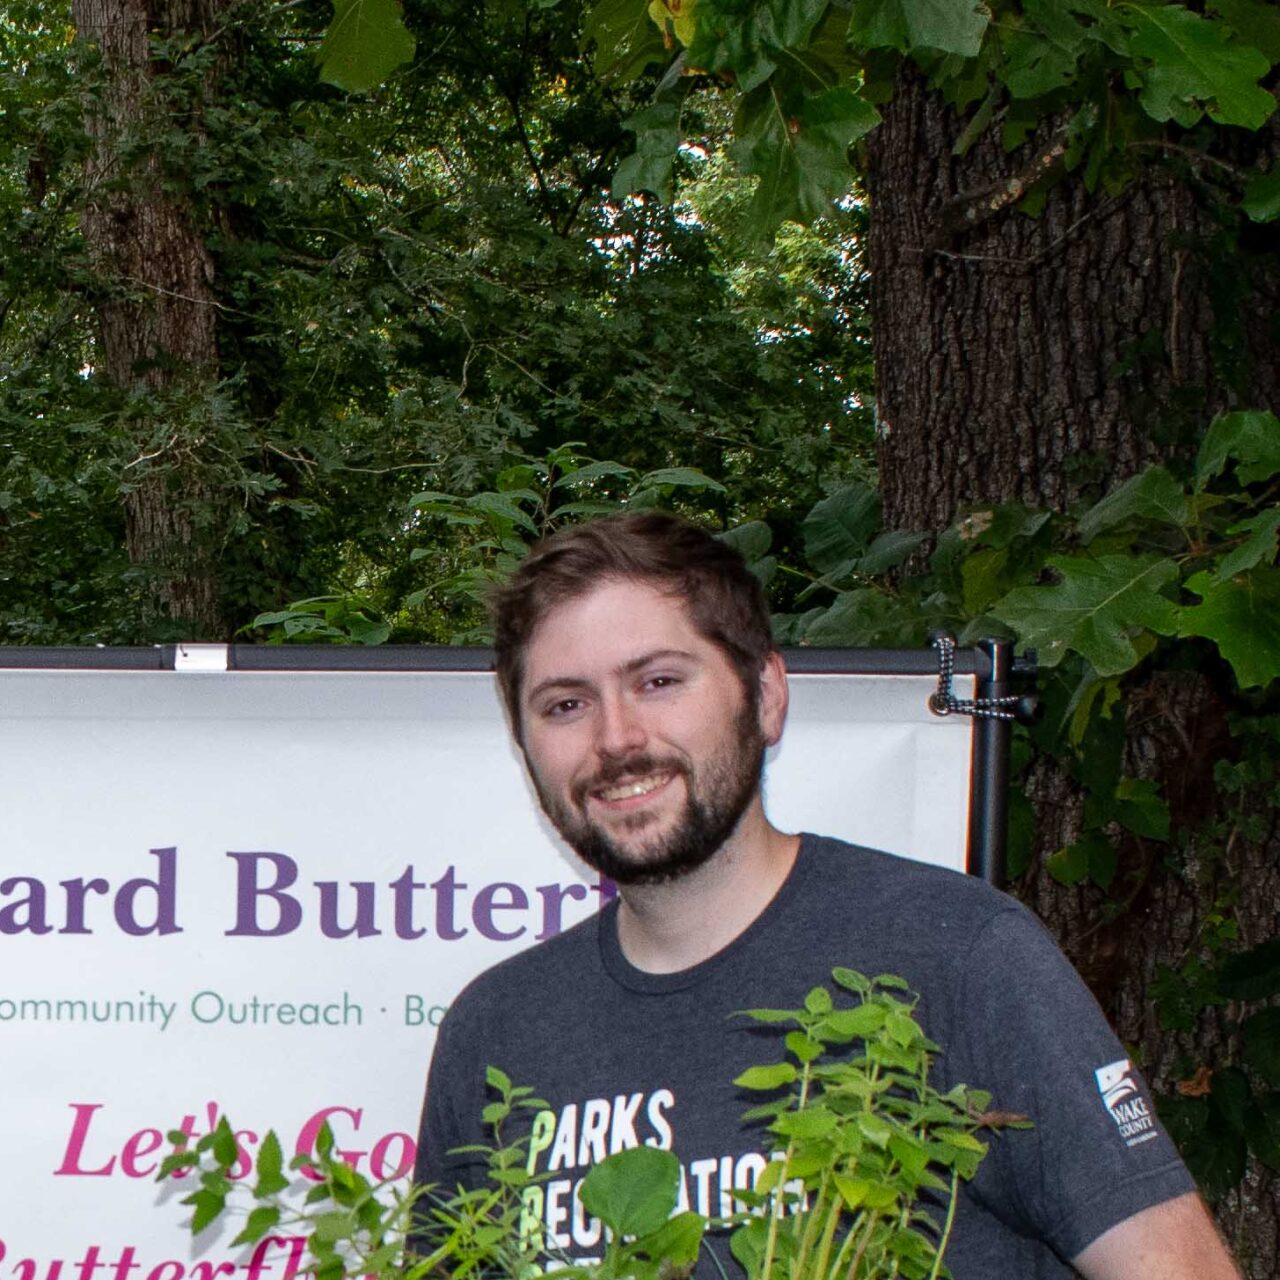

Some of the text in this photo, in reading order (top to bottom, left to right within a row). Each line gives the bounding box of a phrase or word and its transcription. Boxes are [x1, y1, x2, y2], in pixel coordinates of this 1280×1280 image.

[224, 850, 618, 942] Butter
[189, 989, 363, 1026] Outreach
[52, 1101, 418, 1182] Let's Go
[526, 1088, 675, 1176] PARKS
[1119, 1115, 1154, 1138] COUNTY
